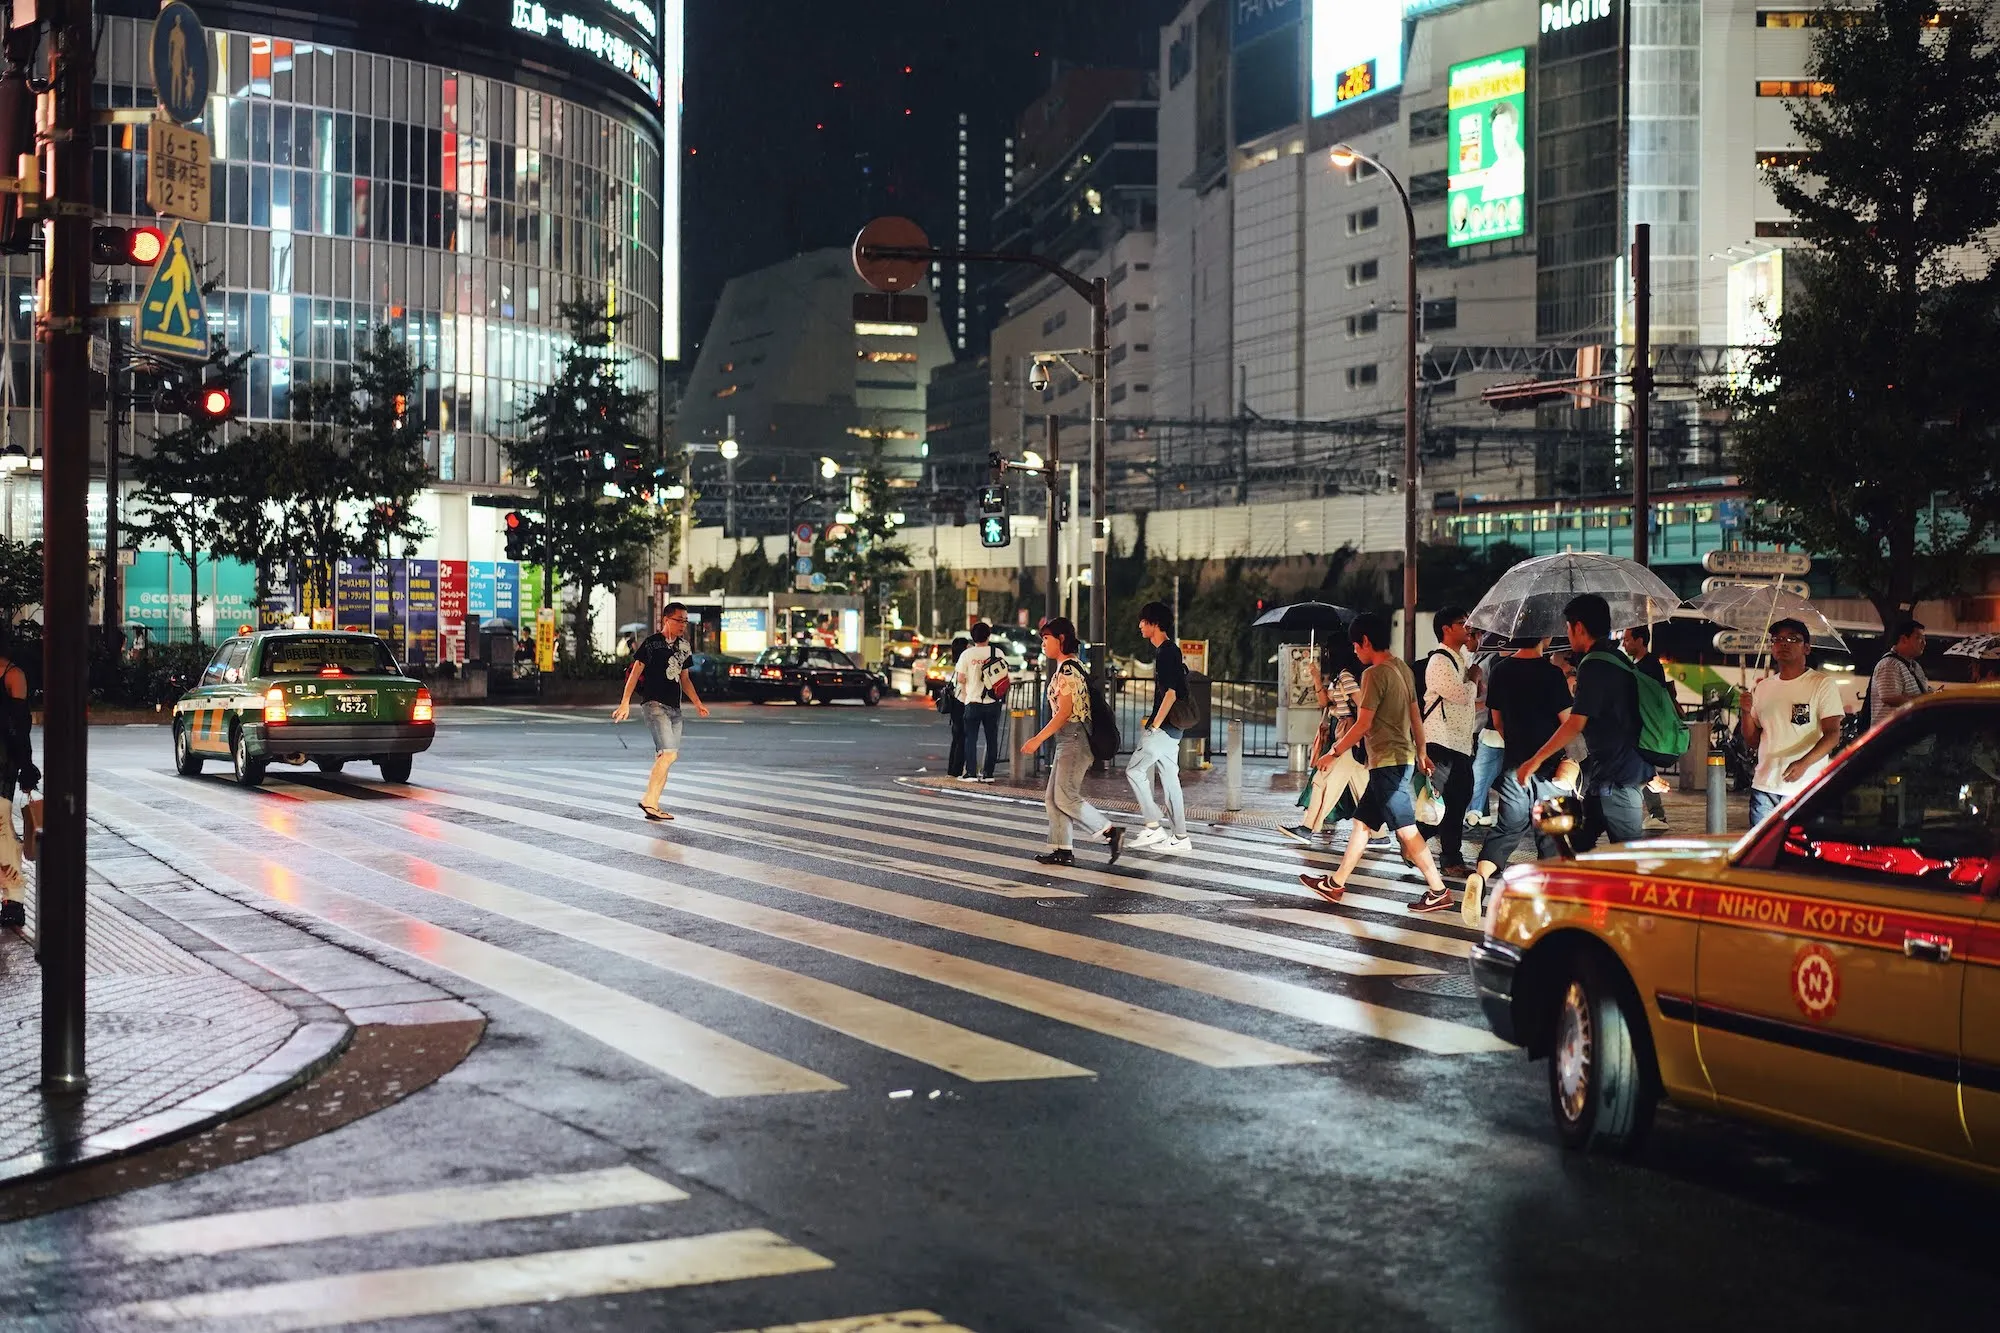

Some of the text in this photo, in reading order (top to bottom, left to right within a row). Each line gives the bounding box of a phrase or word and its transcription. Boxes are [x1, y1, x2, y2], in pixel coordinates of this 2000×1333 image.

[161, 129, 199, 163] 16-5
[159, 181, 199, 212] 12-5
[339, 560, 353, 575] B2
[409, 562, 421, 577] 1F
[441, 563, 453, 578] 2F
[470, 565, 479, 578] 3F
[497, 566, 506, 579] 4F
[340, 702, 368, 713] 45-22
[1628, 880, 1885, 938] TAXI NIHON KOTSU
[1809, 972, 1822, 993] N
